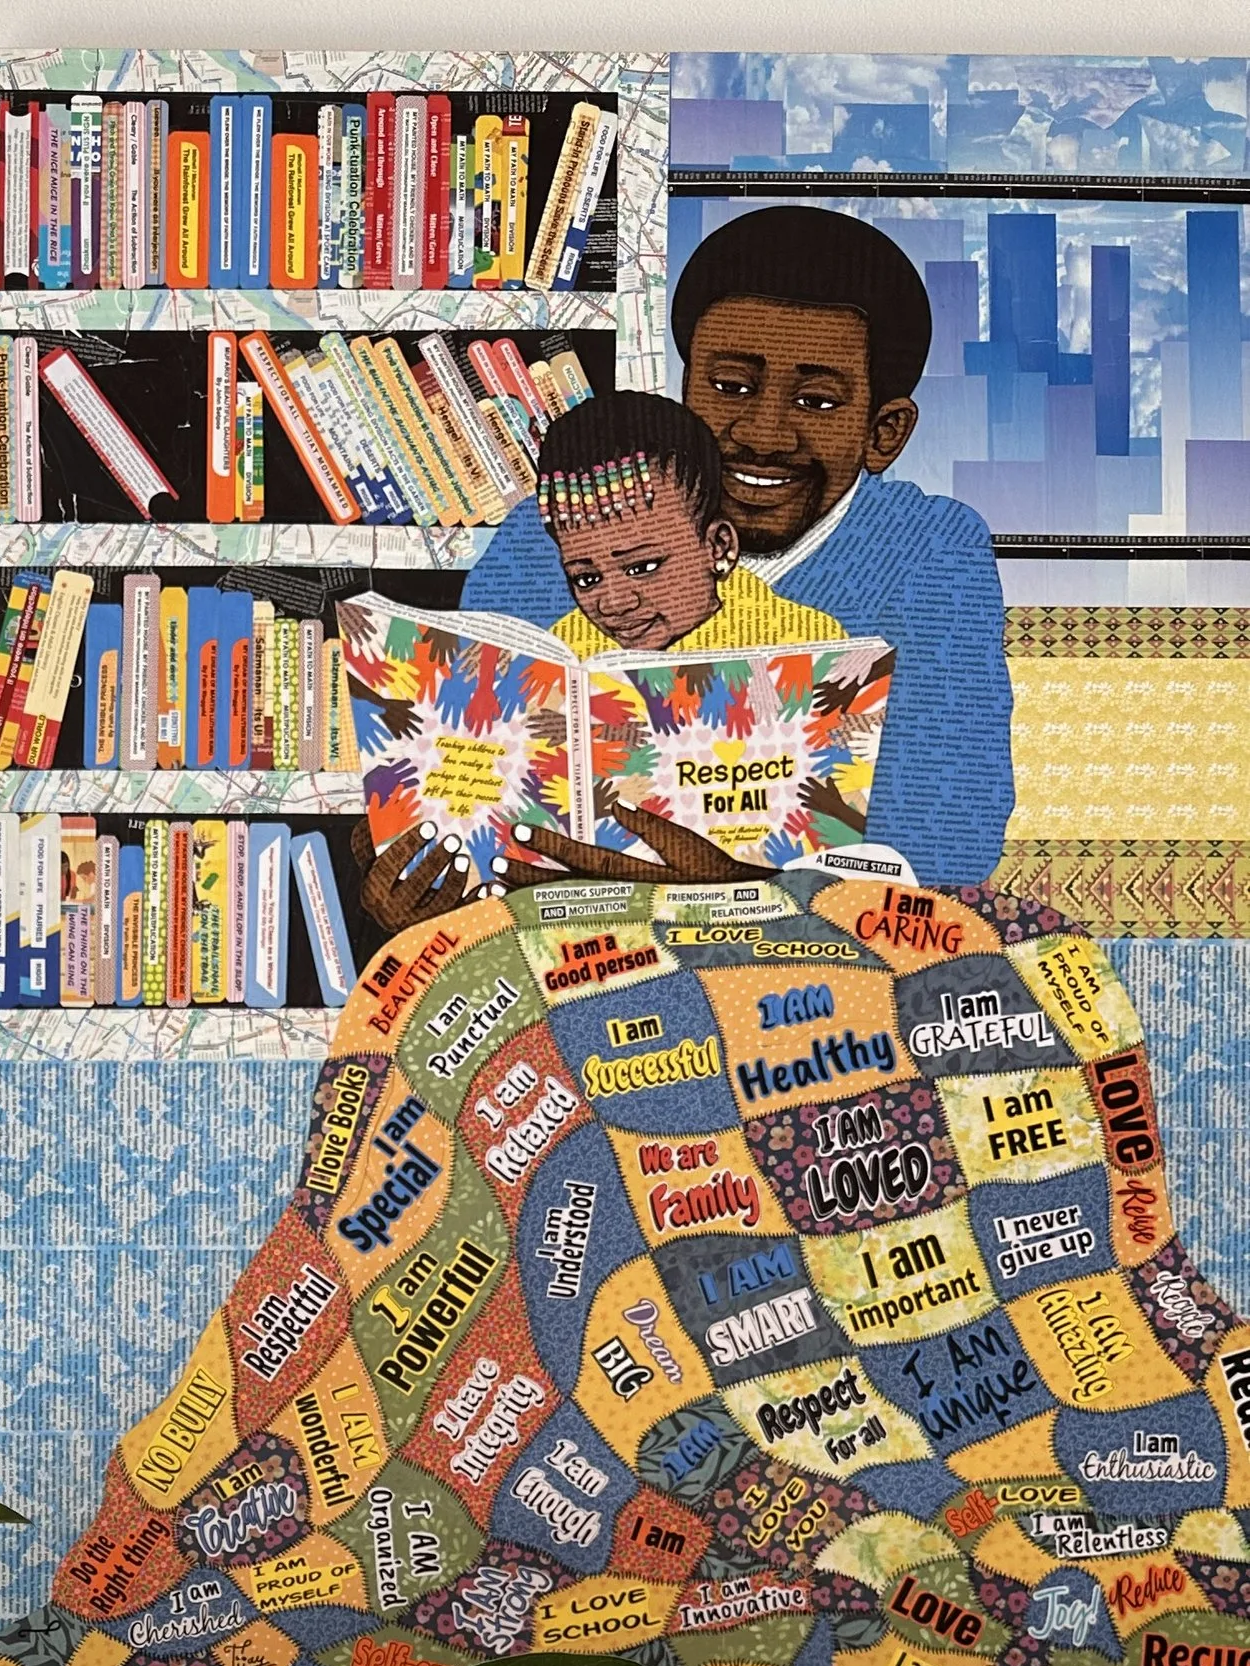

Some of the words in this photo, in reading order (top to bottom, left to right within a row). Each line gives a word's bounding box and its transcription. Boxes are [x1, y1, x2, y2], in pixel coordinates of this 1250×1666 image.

[50, 129, 59, 147] THE
[430, 115, 439, 137] Open
[50, 149, 59, 174] NICE
[181, 149, 190, 163] The
[349, 119, 361, 198] Punk-tuation
[430, 139, 439, 153] and
[429, 155, 438, 177] Close
[50, 176, 59, 201] MICE
[181, 165, 190, 203] Rainforest
[50, 204, 59, 214] IN
[181, 205, 190, 226] Grew
[50, 217, 59, 237] THE
[181, 228, 190, 238] All
[349, 201, 361, 272] Celebration
[50, 239, 59, 263] RICE
[181, 240, 190, 269] Around
[257, 346, 279, 384] RESPECT
[278, 383, 291, 402] FOR
[288, 403, 300, 420] ALL
[318, 457, 348, 509] MOHAMMED
[33, 714, 47, 746] WORLD
[29, 745, 39, 764] OUR
[676, 755, 794, 791] Respect
[704, 793, 735, 814] For
[740, 789, 768, 812] All
[816, 855, 823, 864] A
[827, 857, 869, 872] POSITIVE
[870, 863, 900, 875] START
[535, 888, 587, 900] PROVIDING
[589, 886, 632, 898] SUPPORT
[667, 892, 726, 902] FRIENDSHIPS
[735, 890, 757, 900] AND
[884, 888, 894, 912] I
[900, 892, 934, 917] am
[543, 908, 565, 918] AND
[569, 902, 627, 915] MOTIVATION
[711, 904, 783, 918] RELATIONSHIPS
[562, 943, 570, 963] I
[573, 940, 601, 961] am
[604, 936, 618, 952] a
[669, 930, 682, 943] I
[695, 927, 762, 943] LOVE
[754, 942, 858, 958] SCHOOL
[361, 981, 378, 998] I
[372, 955, 402, 986] am
[545, 966, 592, 991] Good
[596, 947, 659, 983] person
[945, 995, 952, 1020] I
[961, 992, 999, 1017] am
[611, 1024, 622, 1044] I
[626, 1016, 659, 1041] am
[912, 1014, 1052, 1054] GRATEFUL
[584, 1040, 719, 1100] Successful
[327, 1067, 367, 1130] Books
[982, 1095, 995, 1123] I
[1006, 1088, 1053, 1119] am
[815, 1117, 833, 1153] I
[835, 1104, 883, 1147] AM
[988, 1118, 1067, 1160] FREE
[314, 1133, 348, 1177] love
[639, 1142, 674, 1176] We
[678, 1140, 720, 1169] are
[807, 1145, 931, 1221] LOVED
[650, 1171, 760, 1230] Family
[998, 1219, 1006, 1240] I
[1013, 1207, 1079, 1236] never
[862, 1251, 879, 1289] I
[888, 1234, 947, 1269] am
[1000, 1242, 1053, 1276] give
[1060, 1232, 1093, 1260] up
[848, 1268, 981, 1332] important
[756, 1369, 867, 1440] Respect
[136, 1445, 182, 1494] NO
[161, 1368, 227, 1453] BULLY
[859, 1415, 887, 1447] all
[70, 1563, 98, 1585] Do
[87, 1535, 116, 1563] the
[89, 1567, 135, 1615] Right
[123, 1517, 171, 1567] thing
[1109, 1568, 1184, 1614] Reduce
